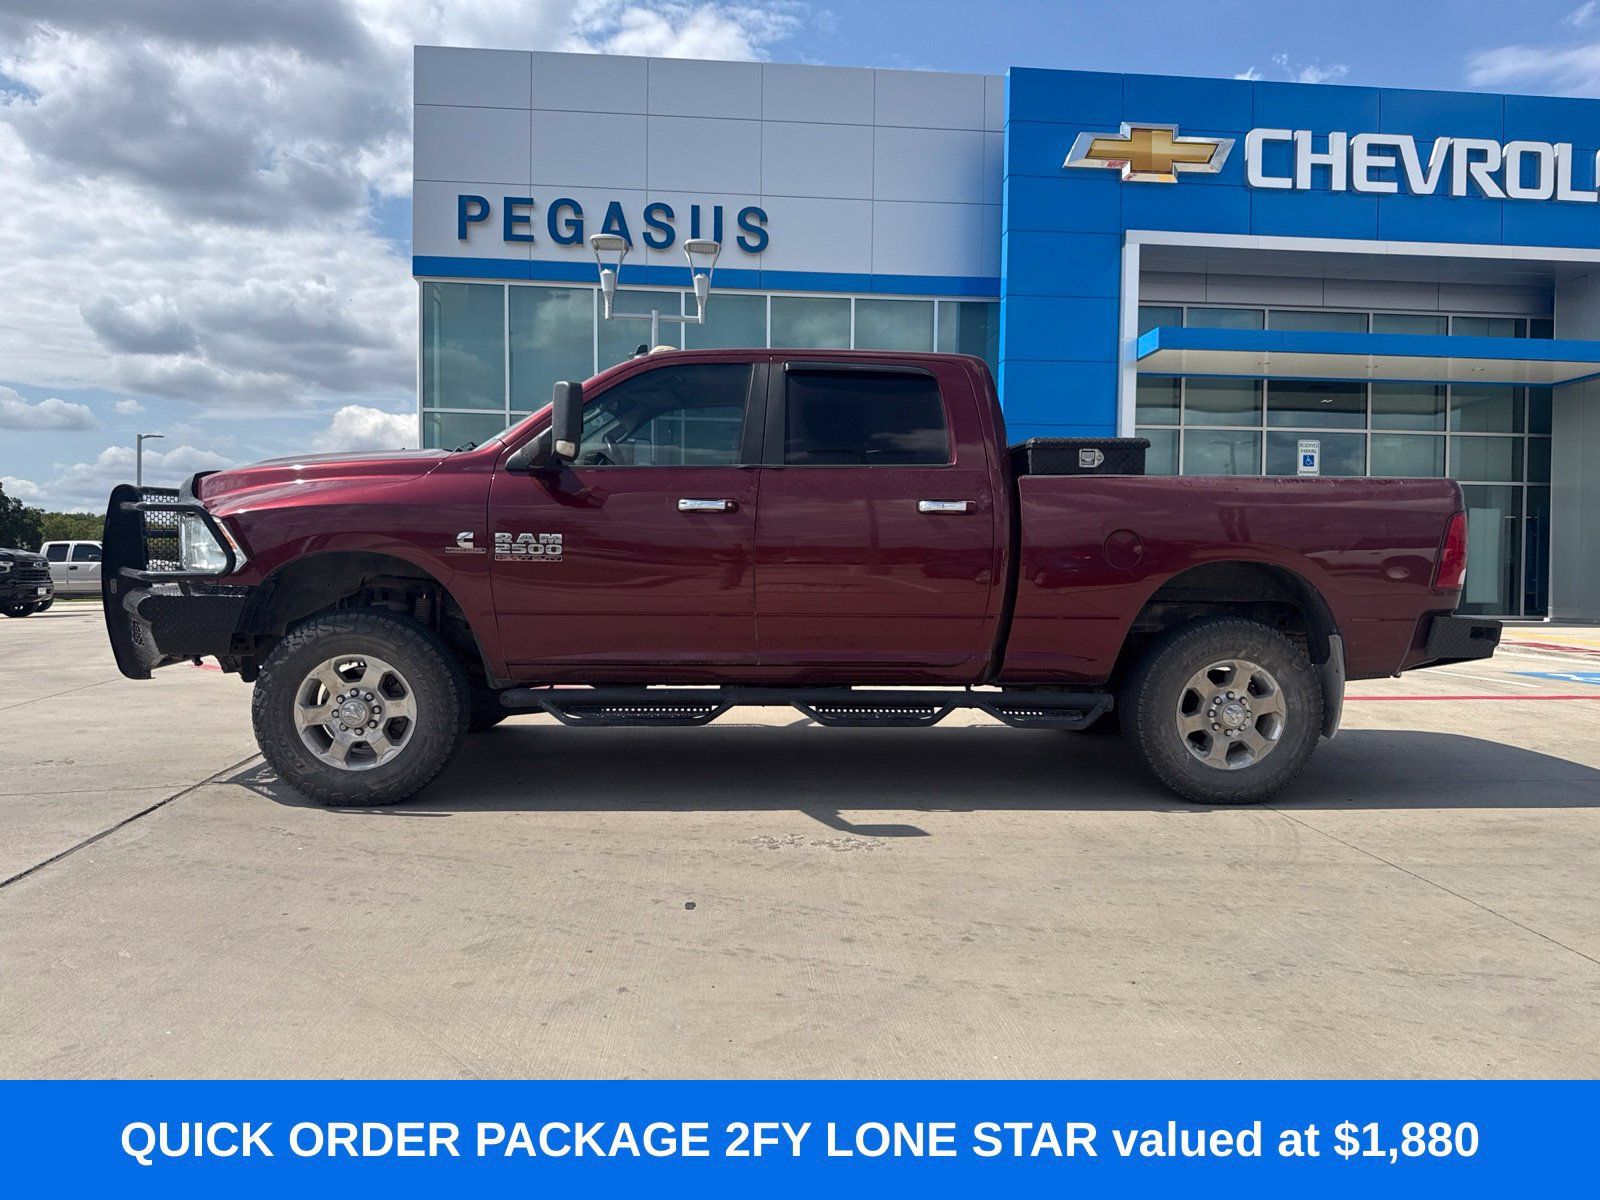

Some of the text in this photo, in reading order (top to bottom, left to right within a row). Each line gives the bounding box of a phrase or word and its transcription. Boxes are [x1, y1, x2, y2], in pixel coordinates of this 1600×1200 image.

[1245, 128, 1600, 203] CHEVROL
[457, 194, 769, 253] PEGASUS
[494, 532, 563, 544] RAM
[494, 543, 563, 555] 2500
